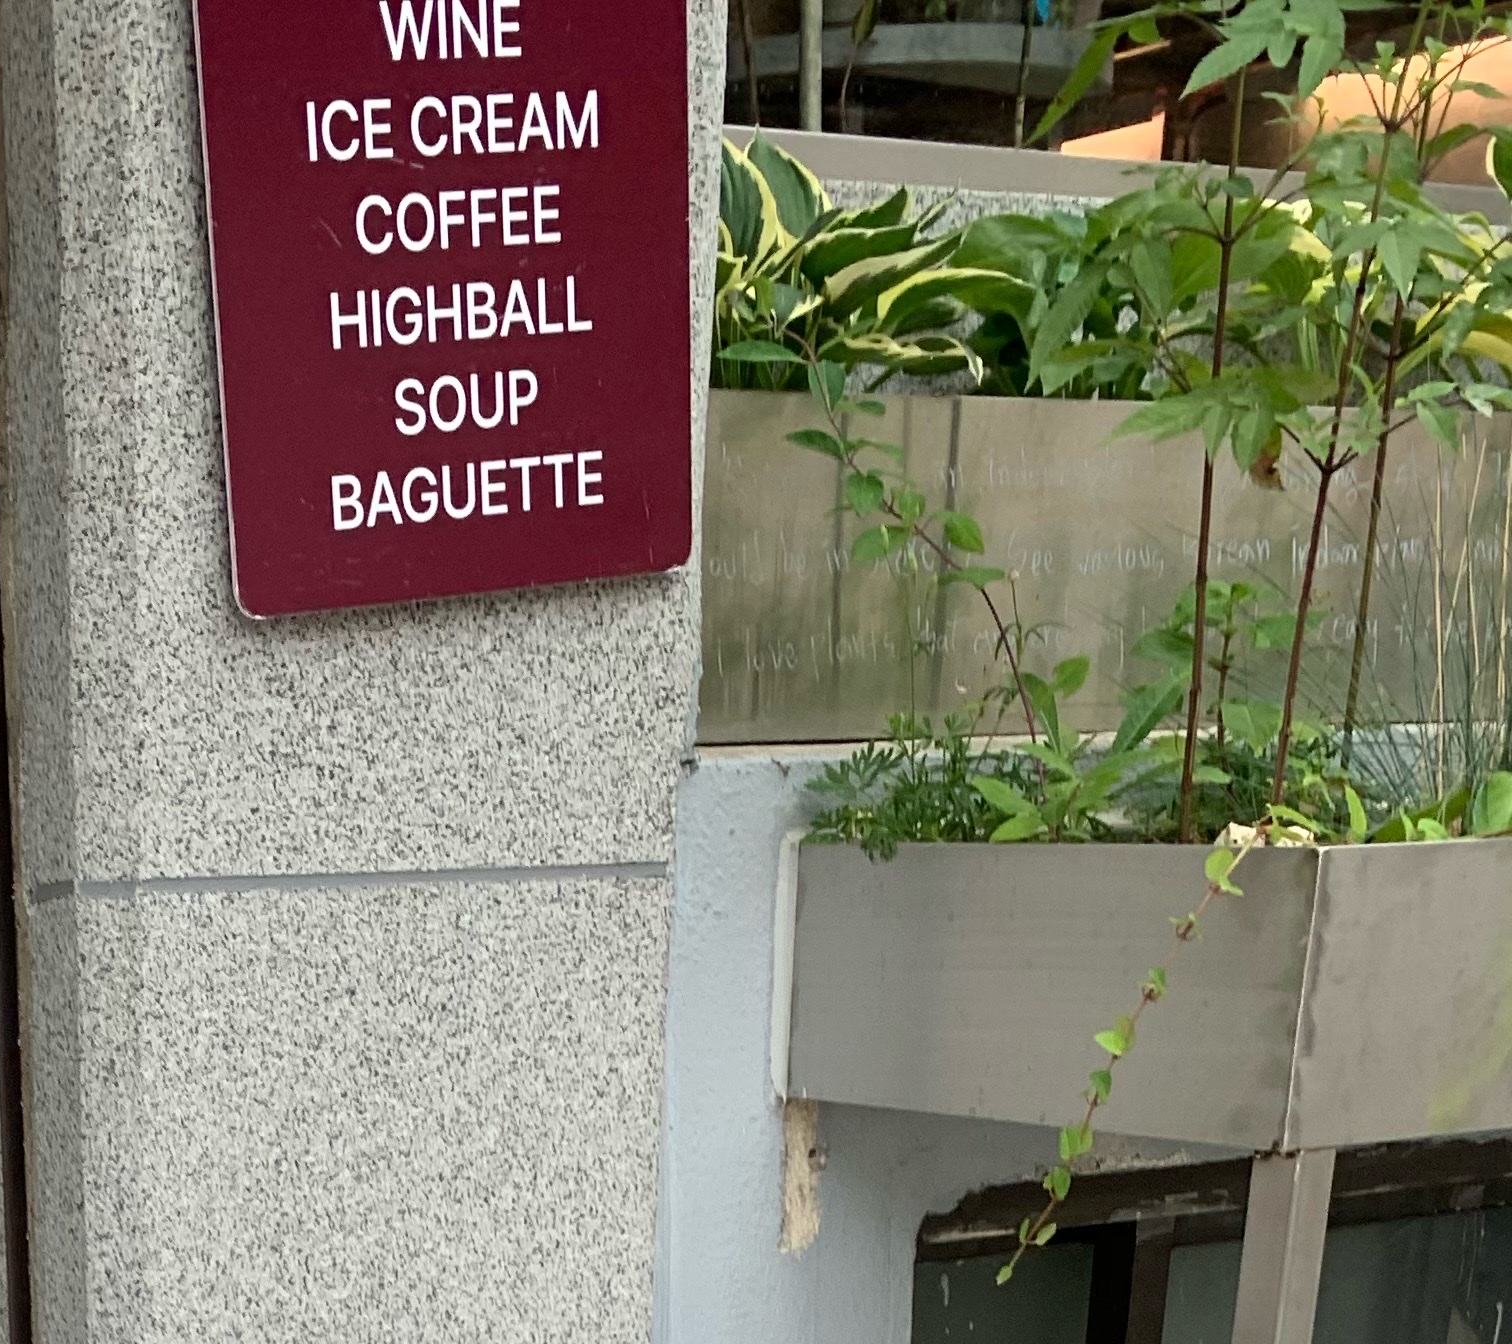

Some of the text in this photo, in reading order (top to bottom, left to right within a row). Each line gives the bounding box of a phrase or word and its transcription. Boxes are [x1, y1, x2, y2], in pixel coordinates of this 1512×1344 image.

[379, 0, 521, 60] WINE
[307, 90, 598, 161] ICE CREAM
[356, 185, 561, 254] COFFEE
[330, 276, 592, 349] HIGHBALL
[395, 370, 538, 435] SOUP
[332, 451, 603, 530] BAGUETTE
